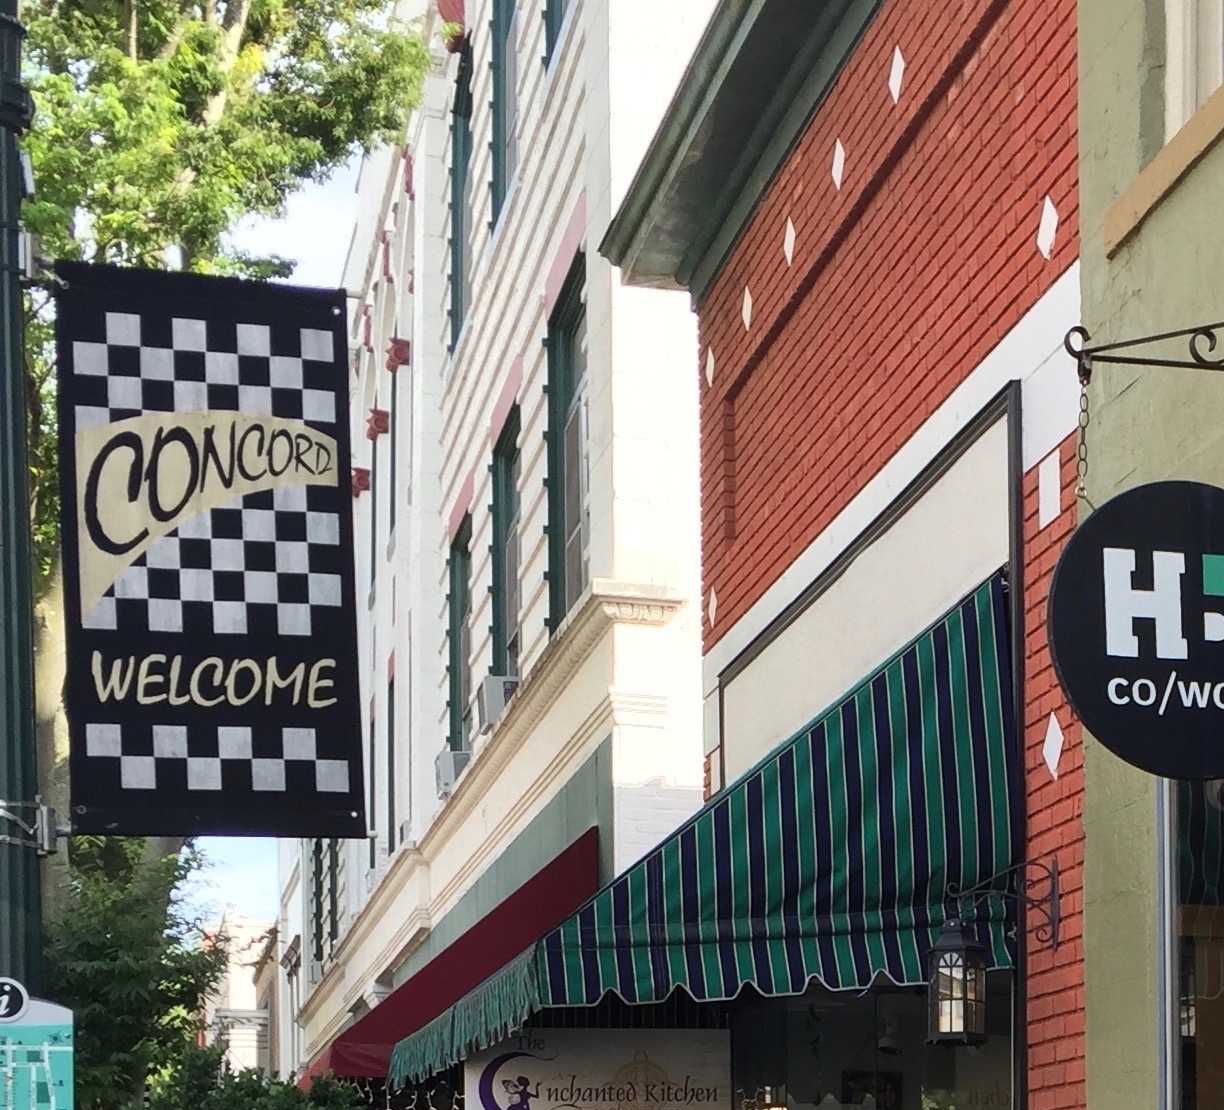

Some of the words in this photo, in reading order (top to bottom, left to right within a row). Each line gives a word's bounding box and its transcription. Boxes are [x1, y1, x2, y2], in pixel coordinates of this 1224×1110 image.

[84, 420, 333, 556] CONCORD
[91, 649, 338, 708] WELCOME
[511, 1029, 546, 1050] The
[644, 1075, 719, 1105] Kitchen
